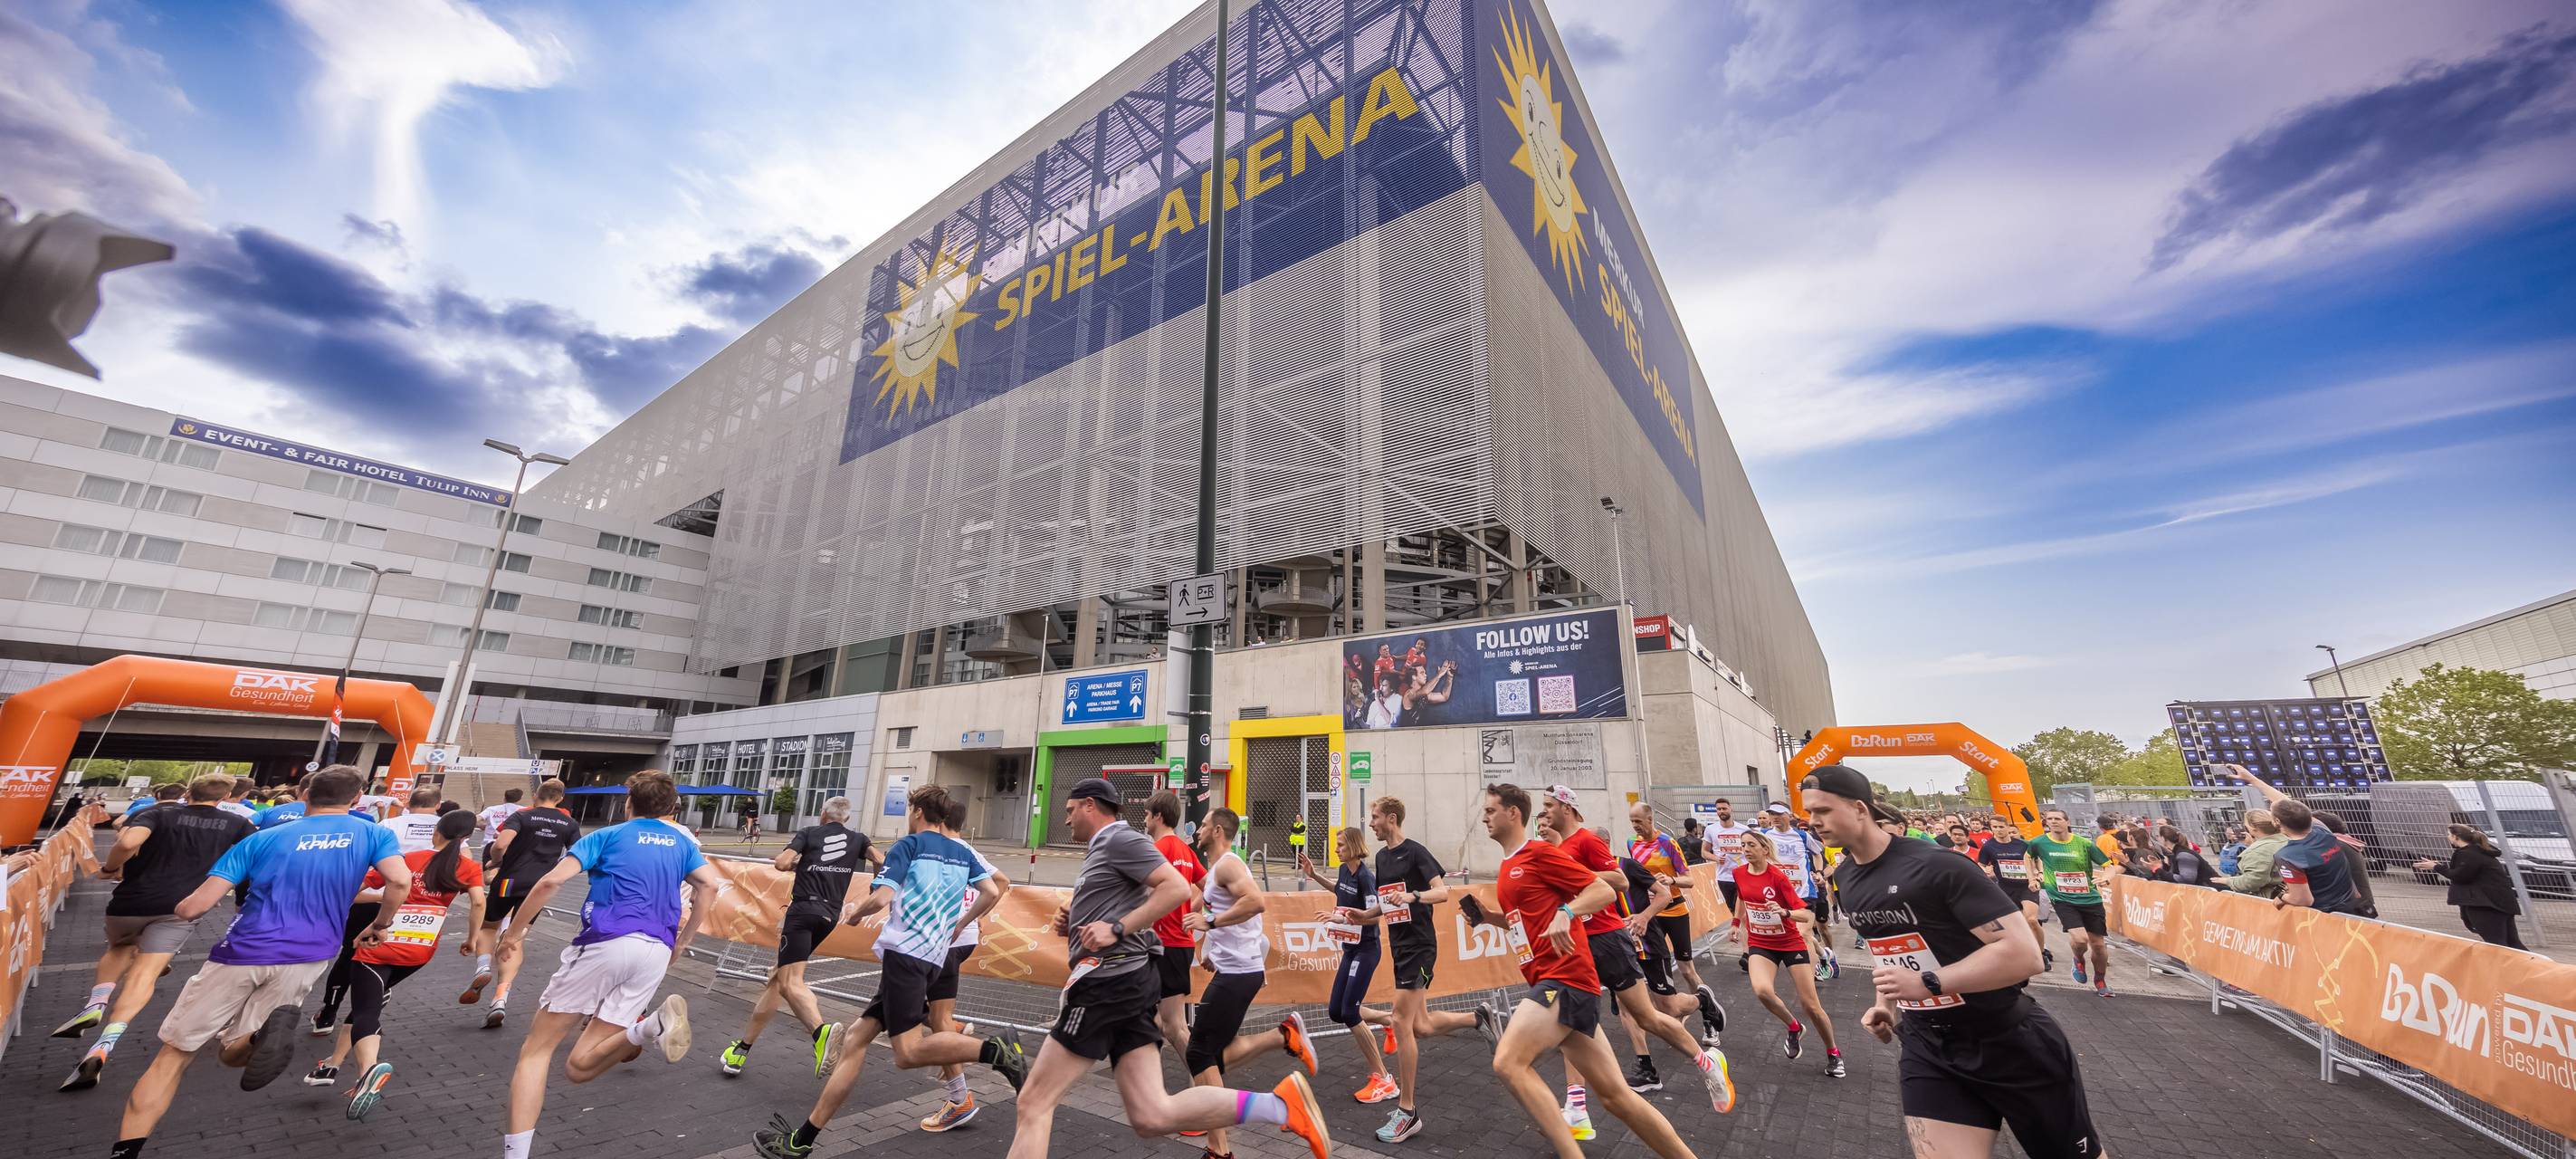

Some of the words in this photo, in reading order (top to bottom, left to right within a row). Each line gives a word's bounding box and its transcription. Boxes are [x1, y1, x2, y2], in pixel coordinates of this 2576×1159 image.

[995, 65, 1419, 332] SPIEL-ARENA
[1592, 205, 1646, 330] MERKUR
[1598, 262, 1696, 468] SPIEL-ARENA
[204, 429, 279, 452] EVENT-
[283, 446, 300, 459] &
[303, 450, 349, 470] FAIR
[353, 462, 408, 483] HOTEL
[1197, 587, 1215, 598] P+R
[1476, 624, 1550, 651] FOLLOW
[1555, 620, 1589, 642] US!
[1633, 623, 1661, 635] NSHOP
[1484, 649, 1496, 659] Alle
[1497, 647, 1514, 658] Infos
[1514, 647, 1521, 656] &
[1522, 643, 1556, 656] Highlights
[1556, 644, 1569, 653] aus
[1570, 642, 1583, 651] der
[234, 671, 320, 694] DAK
[1086, 683, 1102, 691] ARENA
[1106, 680, 1123, 689] MESSE
[229, 685, 315, 704] Gesundheit
[1091, 689, 1117, 698] PARKHAUS
[737, 743, 756, 754] HOTEL
[1804, 742, 1835, 770] Start
[1959, 741, 1999, 769] Start
[296, 837, 352, 852] KPMG
[637, 835, 676, 848] KPMG
[806, 864, 853, 874] #TeamEricsson
[420, 888, 443, 897] Team
[401, 915, 435, 925] 9289
[1751, 910, 1771, 920] 3935
[1283, 922, 1343, 953] DA
[1287, 952, 1343, 972] Gesund
[2380, 963, 2491, 1058] B2Run
